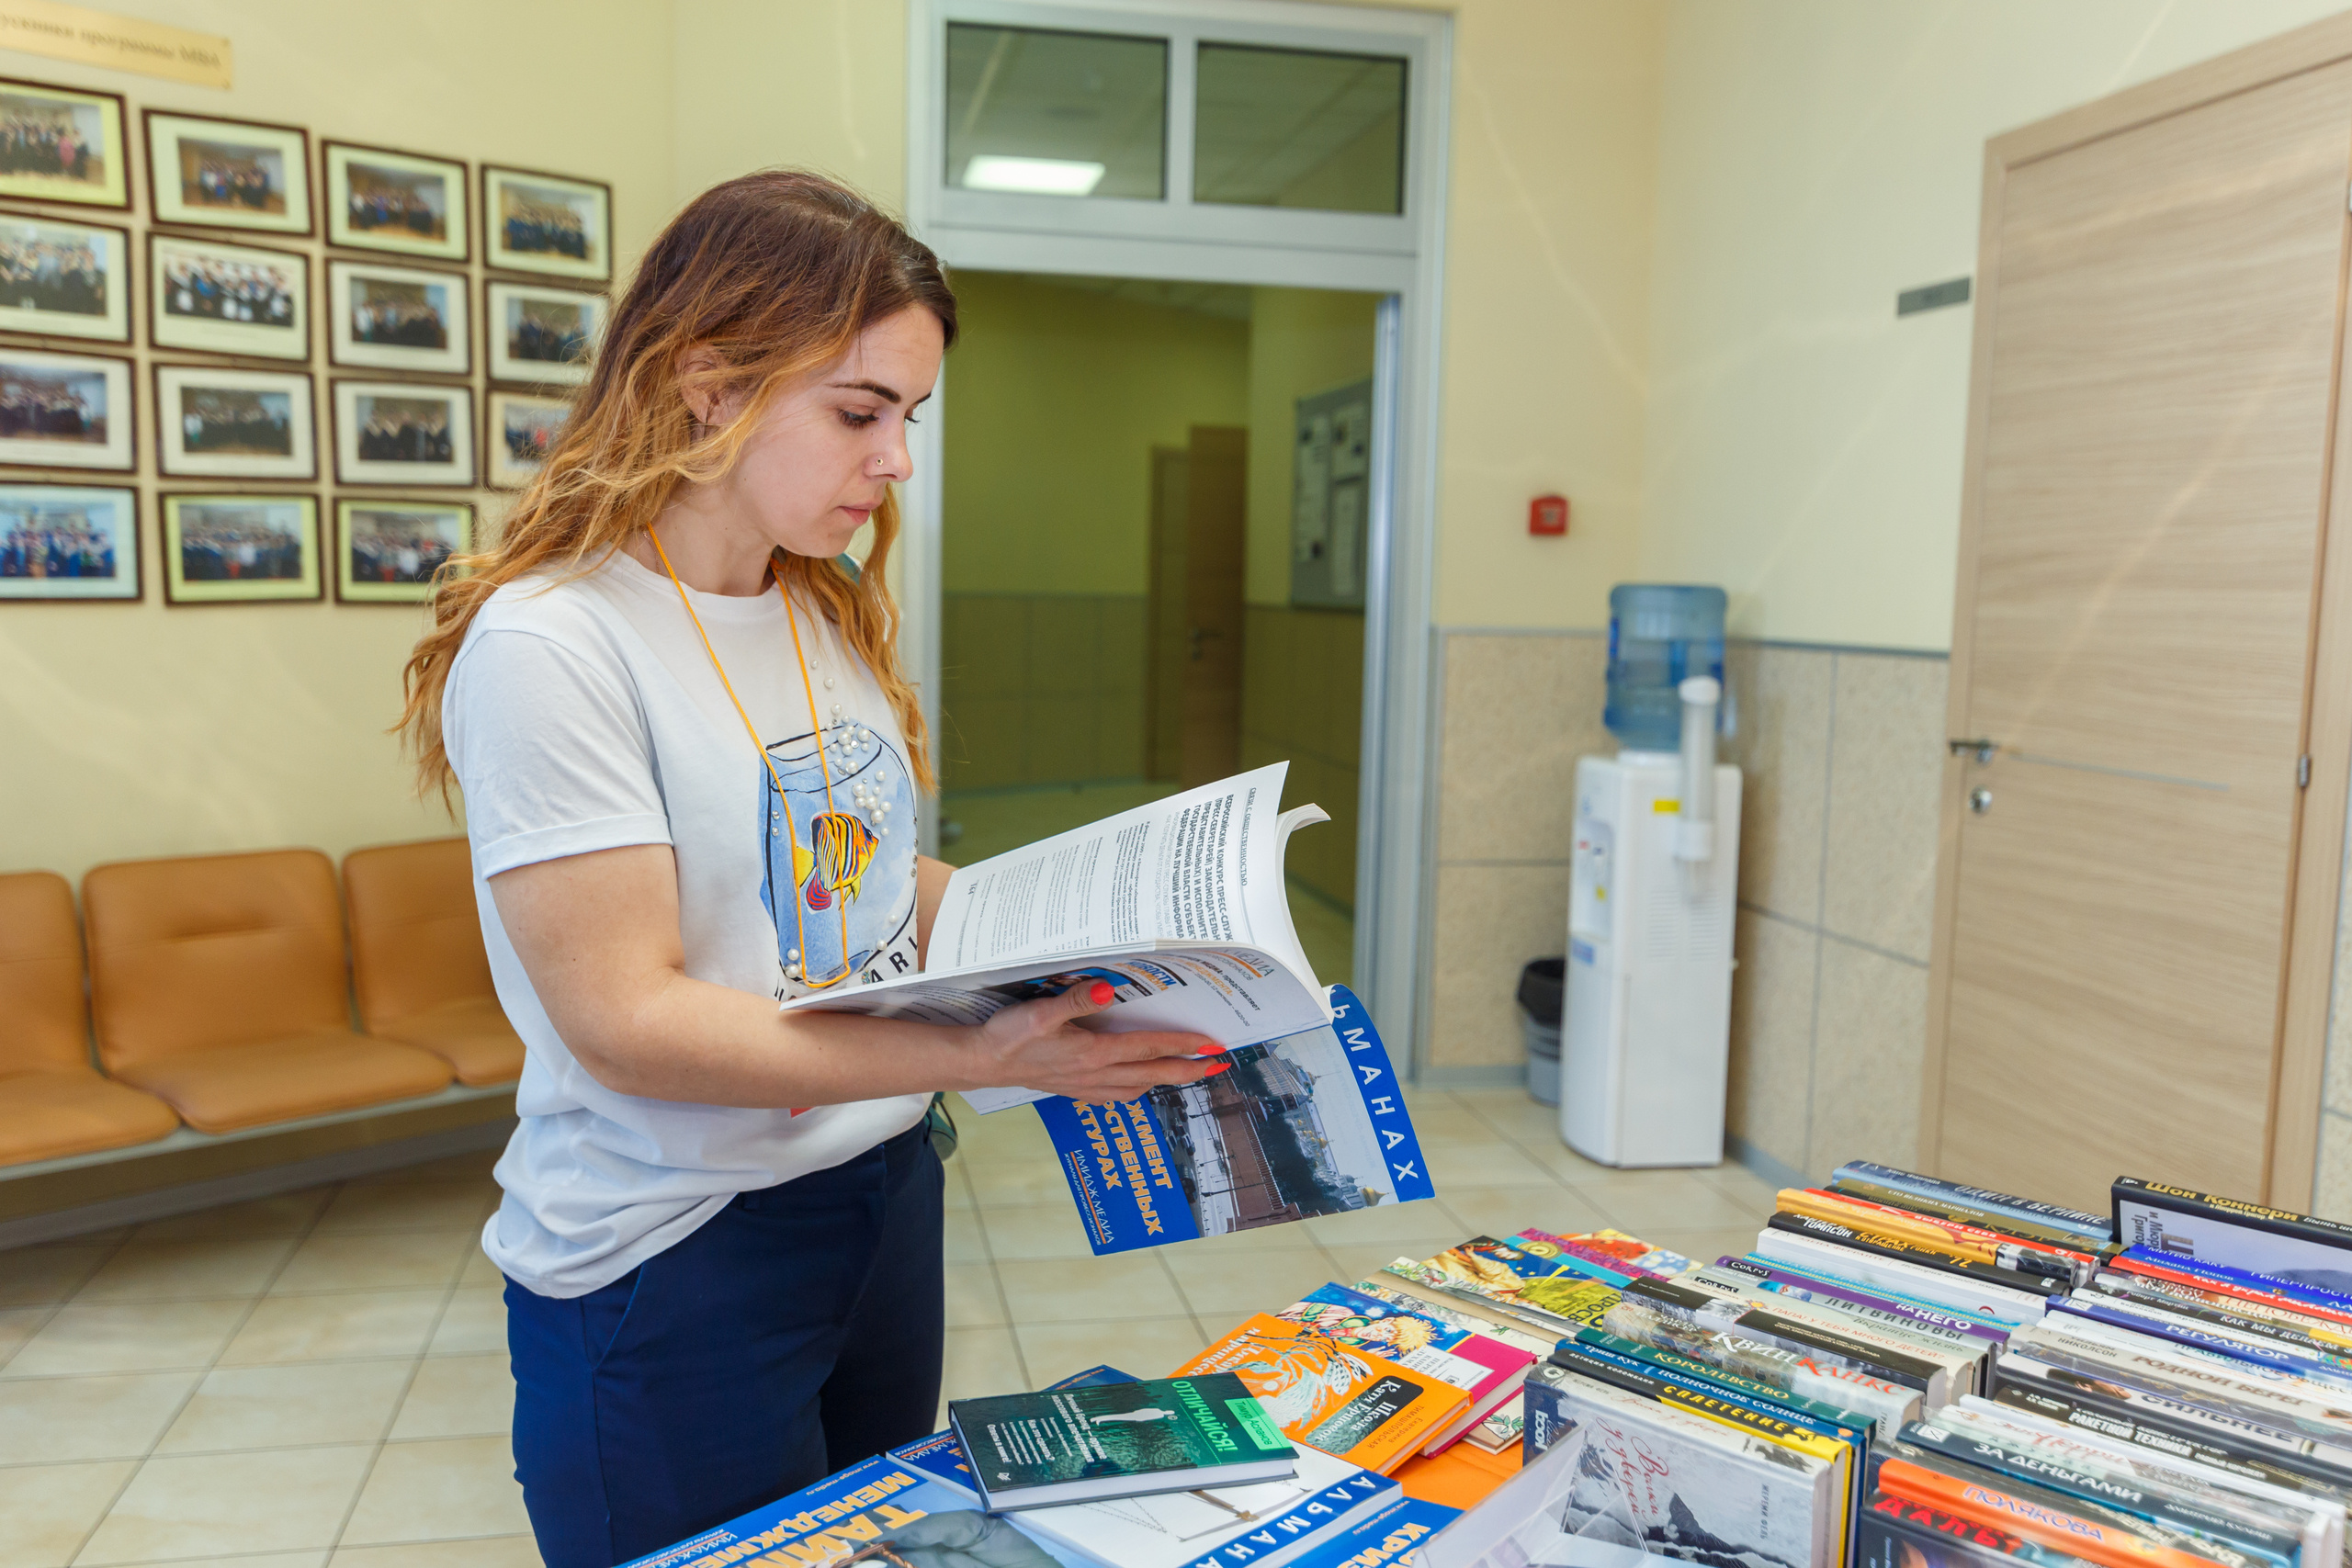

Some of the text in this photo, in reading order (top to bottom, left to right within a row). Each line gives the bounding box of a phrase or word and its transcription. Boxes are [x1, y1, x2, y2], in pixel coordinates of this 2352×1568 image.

[1176, 808, 1191, 848] ФЕДЕРАЦИИ
[1183, 805, 1201, 868] ГОСУДАРСТВЕННОЙ
[1172, 860, 1181, 894] ЛУЧШИЙ
[1182, 869, 1192, 899] ВЛАСТИ
[1216, 794, 1234, 942] ВСЕРОССИЙСКИЙ КОНКУРС ПРЕСС-СЛУЖ
[1193, 886, 1208, 940] ИСПОЛНИТЕ
[1222, 975, 1261, 1011] представляет
[1078, 1191, 1102, 1246] ПРОФЕССИОНАЛОВ
[2145, 1182, 2338, 1229] Шон Коннери Быть
[1803, 1220, 1853, 1238] ТОМПСОН
[1966, 1227, 1997, 1239] СЕБЯ
[2194, 1257, 2228, 1269] КАКУ
[1820, 1318, 1850, 1333] ТЕБЯ
[1852, 1330, 1895, 1347] МНОГО
[1825, 1297, 1963, 1341] ЛИТВИНОВЫ
[1915, 1309, 1972, 1331] НЕГО
[2220, 1314, 2247, 1328] КАК
[2250, 1323, 2277, 1336] МЫ
[2279, 1330, 2339, 1351] ДЕЛАЕМ
[2058, 1337, 2118, 1358] НИКОЛСОН
[2165, 1324, 2290, 1361] РЕГУЛЯТОР
[1654, 1351, 1791, 1400] КОРОЛЕВСТВО
[2235, 1379, 2311, 1406] БЕРЕГ
[1051, 1394, 1073, 1423] массового
[1067, 1424, 1095, 1462] впечатления
[1171, 1381, 1238, 1452] ОТЛИЧАЙСЯ!
[1235, 1401, 1253, 1420] Тимур
[1317, 1380, 1403, 1443] Кати Ершовой
[1351, 1401, 1398, 1433] Школа
[1367, 1404, 1425, 1450] ТИМАШПОЛЬСКАЯ
[1663, 1385, 1789, 1432] СПЛЕТЕНИЕ
[1752, 1398, 1817, 1425] СОЛНЦЕ
[2141, 1394, 2294, 1443] СИЛЬНЕЕ
[987, 1424, 1001, 1442] Ответы
[1388, 1417, 1425, 1444] Екатерина
[2068, 1411, 2134, 1440] РАКЕТНОЙ
[2134, 1429, 2193, 1457] ТЕХНИКИ
[1630, 1435, 1669, 1516] Волки
[1973, 1442, 2004, 1461] ЗА
[2007, 1454, 2143, 1504] ДЕНЬГАМИ
[1759, 1483, 1770, 1540] ЖЕРЕМИ ФЕЛЬ
[1962, 1485, 2104, 1543] ПОЛЯКОВА
